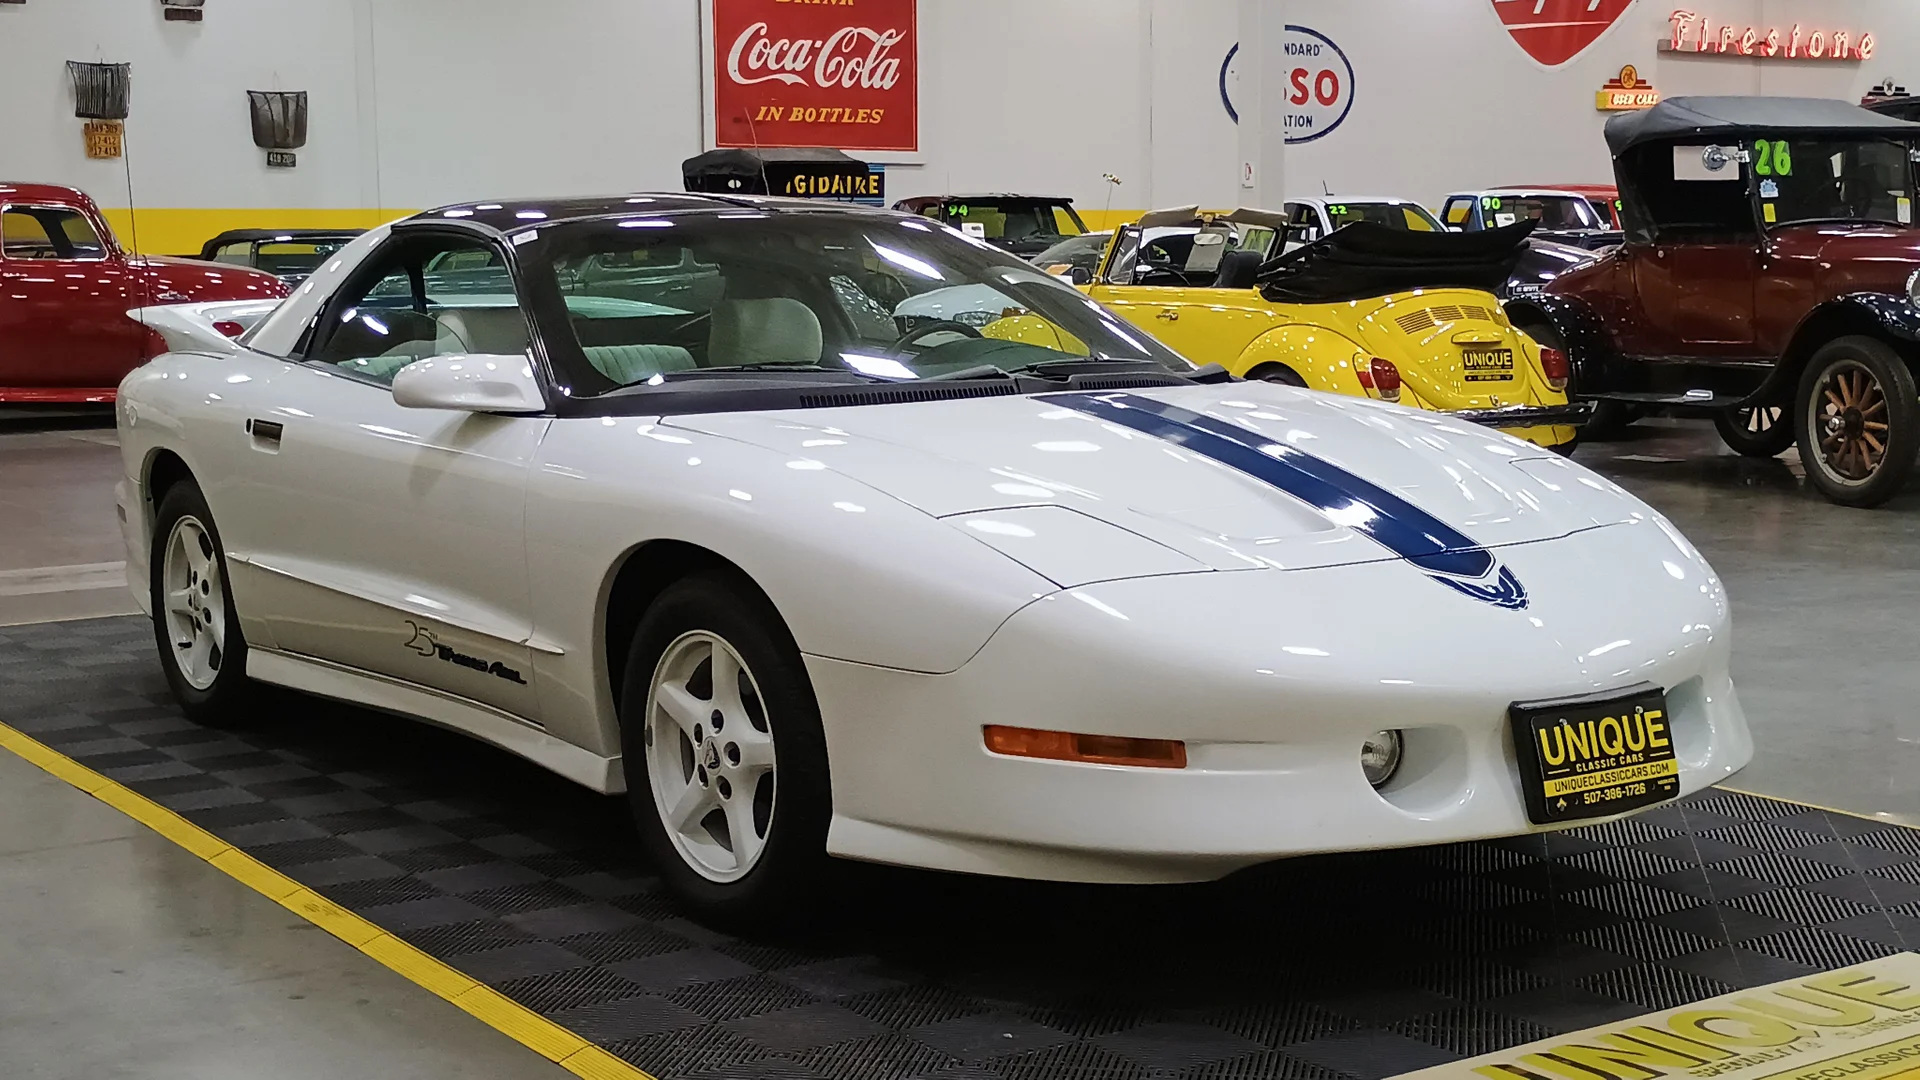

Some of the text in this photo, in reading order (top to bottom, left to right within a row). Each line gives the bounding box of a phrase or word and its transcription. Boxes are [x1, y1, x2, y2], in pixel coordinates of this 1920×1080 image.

[1669, 9, 1874, 60] Firestone
[1284, 67, 1339, 106] SO
[755, 106, 884, 124] IN BOTTLES
[1755, 139, 1791, 176] 26
[949, 205, 968, 216] 94
[1329, 205, 1348, 215] 22
[1482, 198, 1501, 210] 90
[1464, 351, 1512, 367] UNIQUE
[1539, 710, 1669, 766] UNIQUE
[1576, 752, 1645, 773] CLASSIC CARS
[1554, 762, 1670, 793] UNIQUECLASSICCARS.COM
[1584, 782, 1646, 805] 507-386-1726
